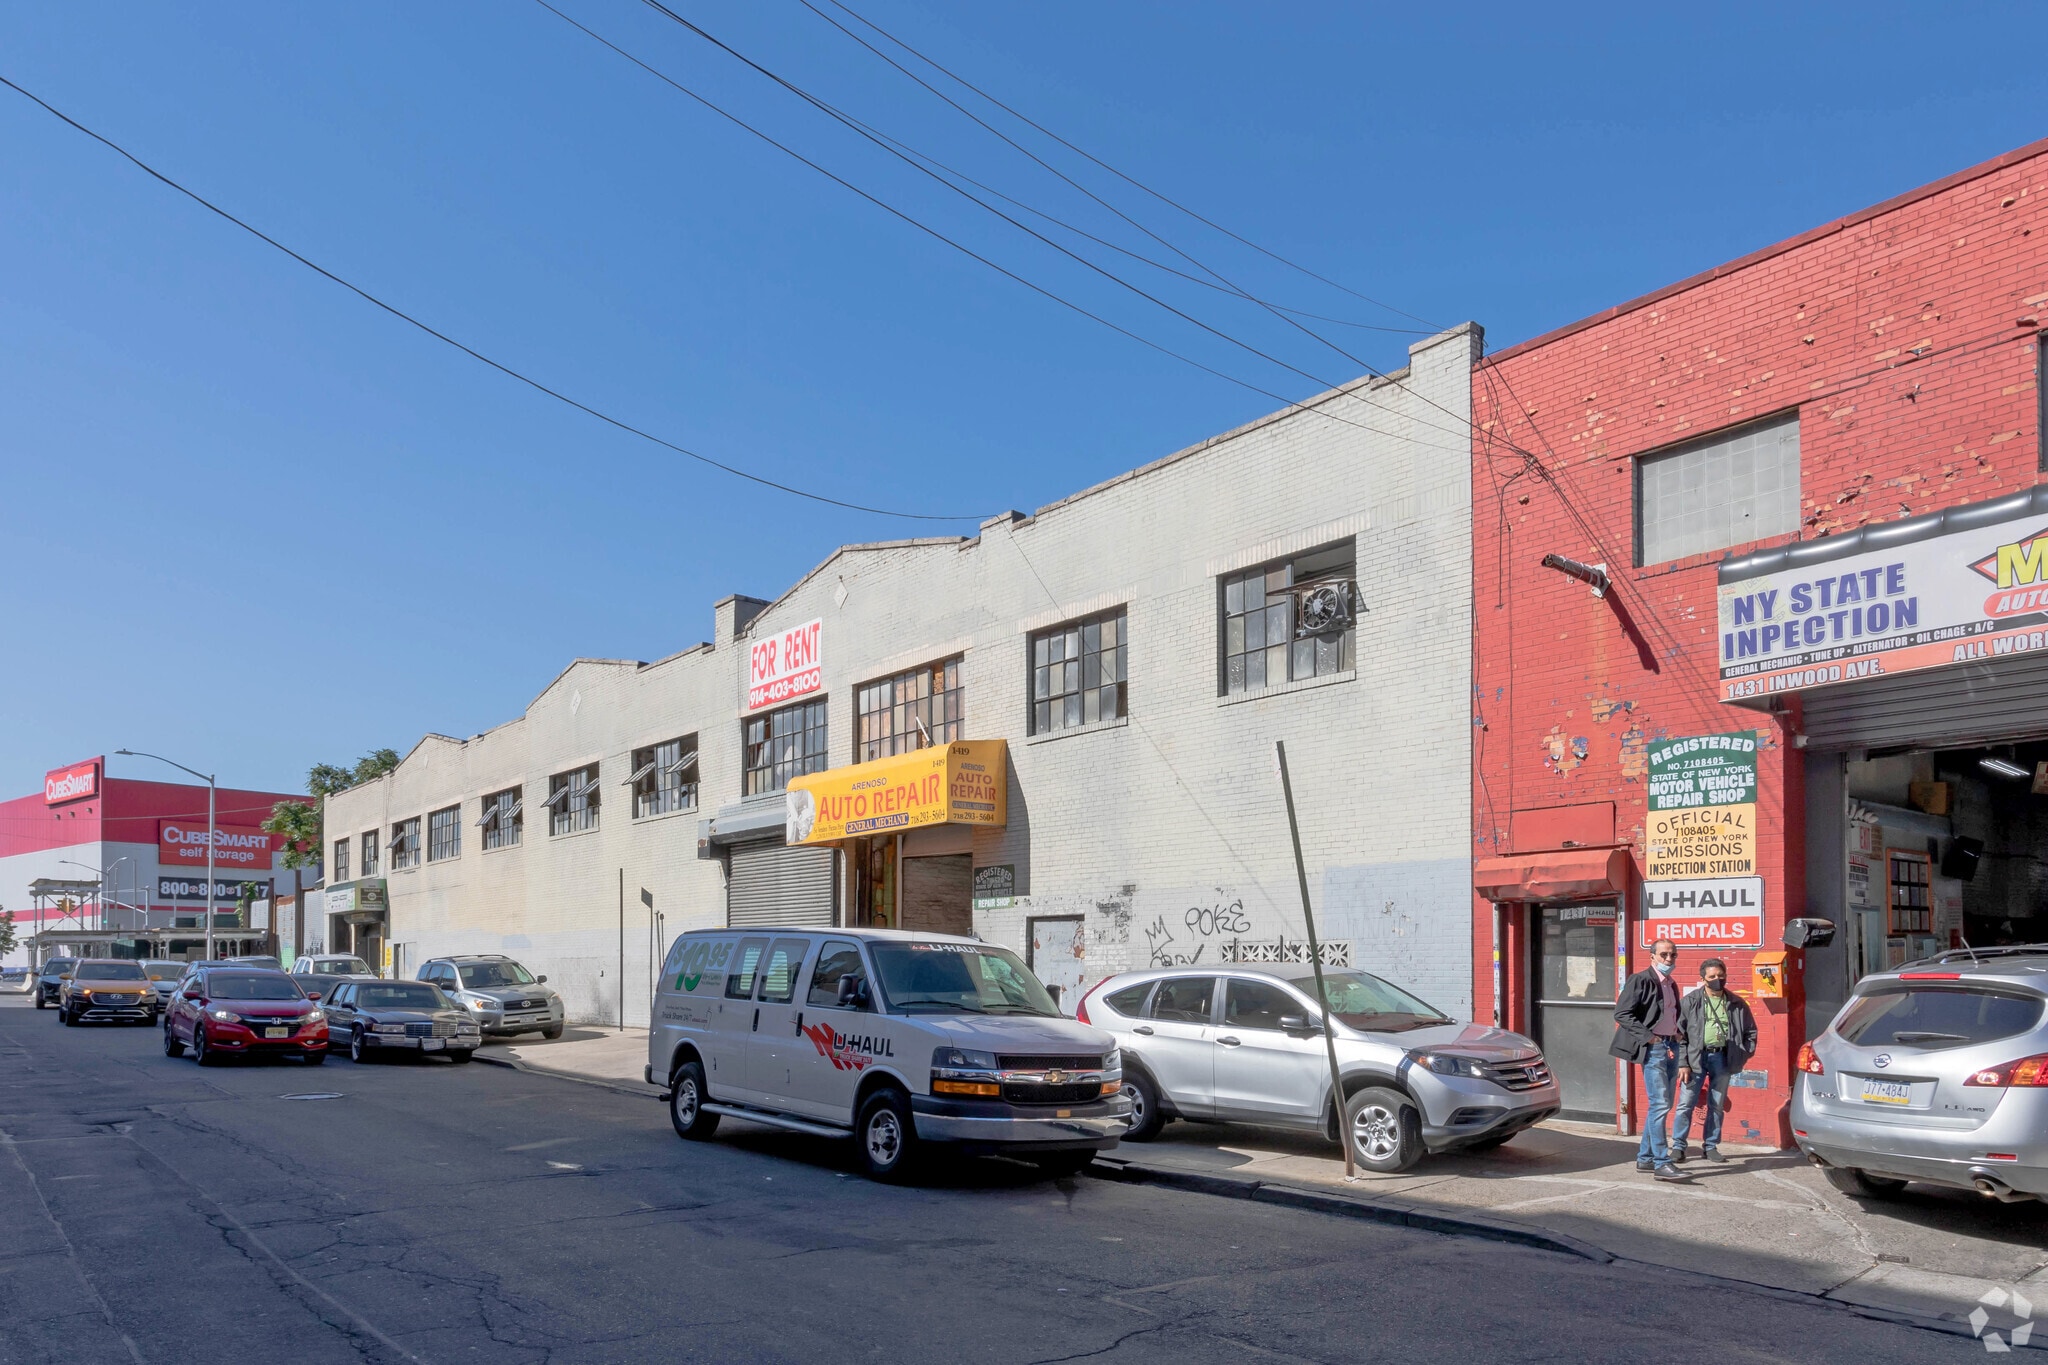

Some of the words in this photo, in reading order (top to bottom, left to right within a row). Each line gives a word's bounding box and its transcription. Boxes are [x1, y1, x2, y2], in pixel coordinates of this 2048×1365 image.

[1734, 589, 1778, 626] NY
[1790, 562, 1905, 614] STATE
[1724, 596, 1918, 661] INPECTION
[751, 640, 777, 683] FOR
[785, 622, 820, 672] RENT
[1725, 663, 1759, 678] GENERAL
[1760, 655, 1803, 671] MECHANIC
[1810, 651, 1832, 663] TUNE
[1834, 648, 1845, 660] UP
[1852, 636, 1908, 655] ALTERNATOR
[1916, 632, 1932, 644] OIL
[1934, 625, 1966, 641] CHAGE
[1974, 620, 1994, 633] A/C
[1953, 643, 1988, 662] ALL
[1726, 678, 1765, 699] 1431
[1769, 665, 1841, 693] INWOOD
[1845, 657, 1886, 680] AVE.
[750, 671, 820, 706] 914-403-8100
[952, 746, 970, 756] 1419
[1650, 736, 1755, 766] REGISTERED
[932, 758, 945, 768] 1419
[1667, 763, 1681, 771] NO.
[1684, 757, 1724, 768] 7108405
[955, 773, 993, 784] AUTO
[1652, 773, 1678, 782] STATE
[1682, 771, 1695, 779] OF
[1698, 769, 1721, 777] NEW
[1725, 765, 1752, 774] YORK
[851, 777, 887, 791] ARENOSO
[950, 784, 996, 800] REPAIR
[1650, 780, 1694, 796] MOTOR
[1699, 773, 1755, 791] VEHICLE
[818, 794, 867, 823] AUTO
[873, 773, 940, 814] REPAIR
[1657, 792, 1704, 808] REPAIR
[1709, 788, 1746, 804] SHOP
[846, 818, 875, 833] GENERAL
[876, 812, 908, 828] MECHANIC
[911, 815, 919, 825] 718
[1657, 810, 1746, 834] OFFICIAL
[1652, 838, 1678, 846] STATE
[1697, 835, 1718, 843] NEW
[1723, 833, 1748, 841] YORK
[1674, 825, 1716, 837] 7108405
[180, 847, 203, 857] self
[1657, 842, 1743, 859] EMISSIONS
[975, 866, 1012, 885] REGISTERED
[1649, 861, 1706, 876] INSPECTION
[1709, 859, 1751, 873] STATION
[978, 899, 995, 908] REPAIR
[996, 897, 1010, 907] SHOP
[1648, 889, 1755, 909] U-HAUL
[1184, 898, 1251, 941] POKE
[1560, 907, 1586, 920] 1431
[1656, 922, 1745, 939] RENTALS
[929, 944, 981, 954] U-HAUL
[834, 1032, 894, 1057] U-HAUL
